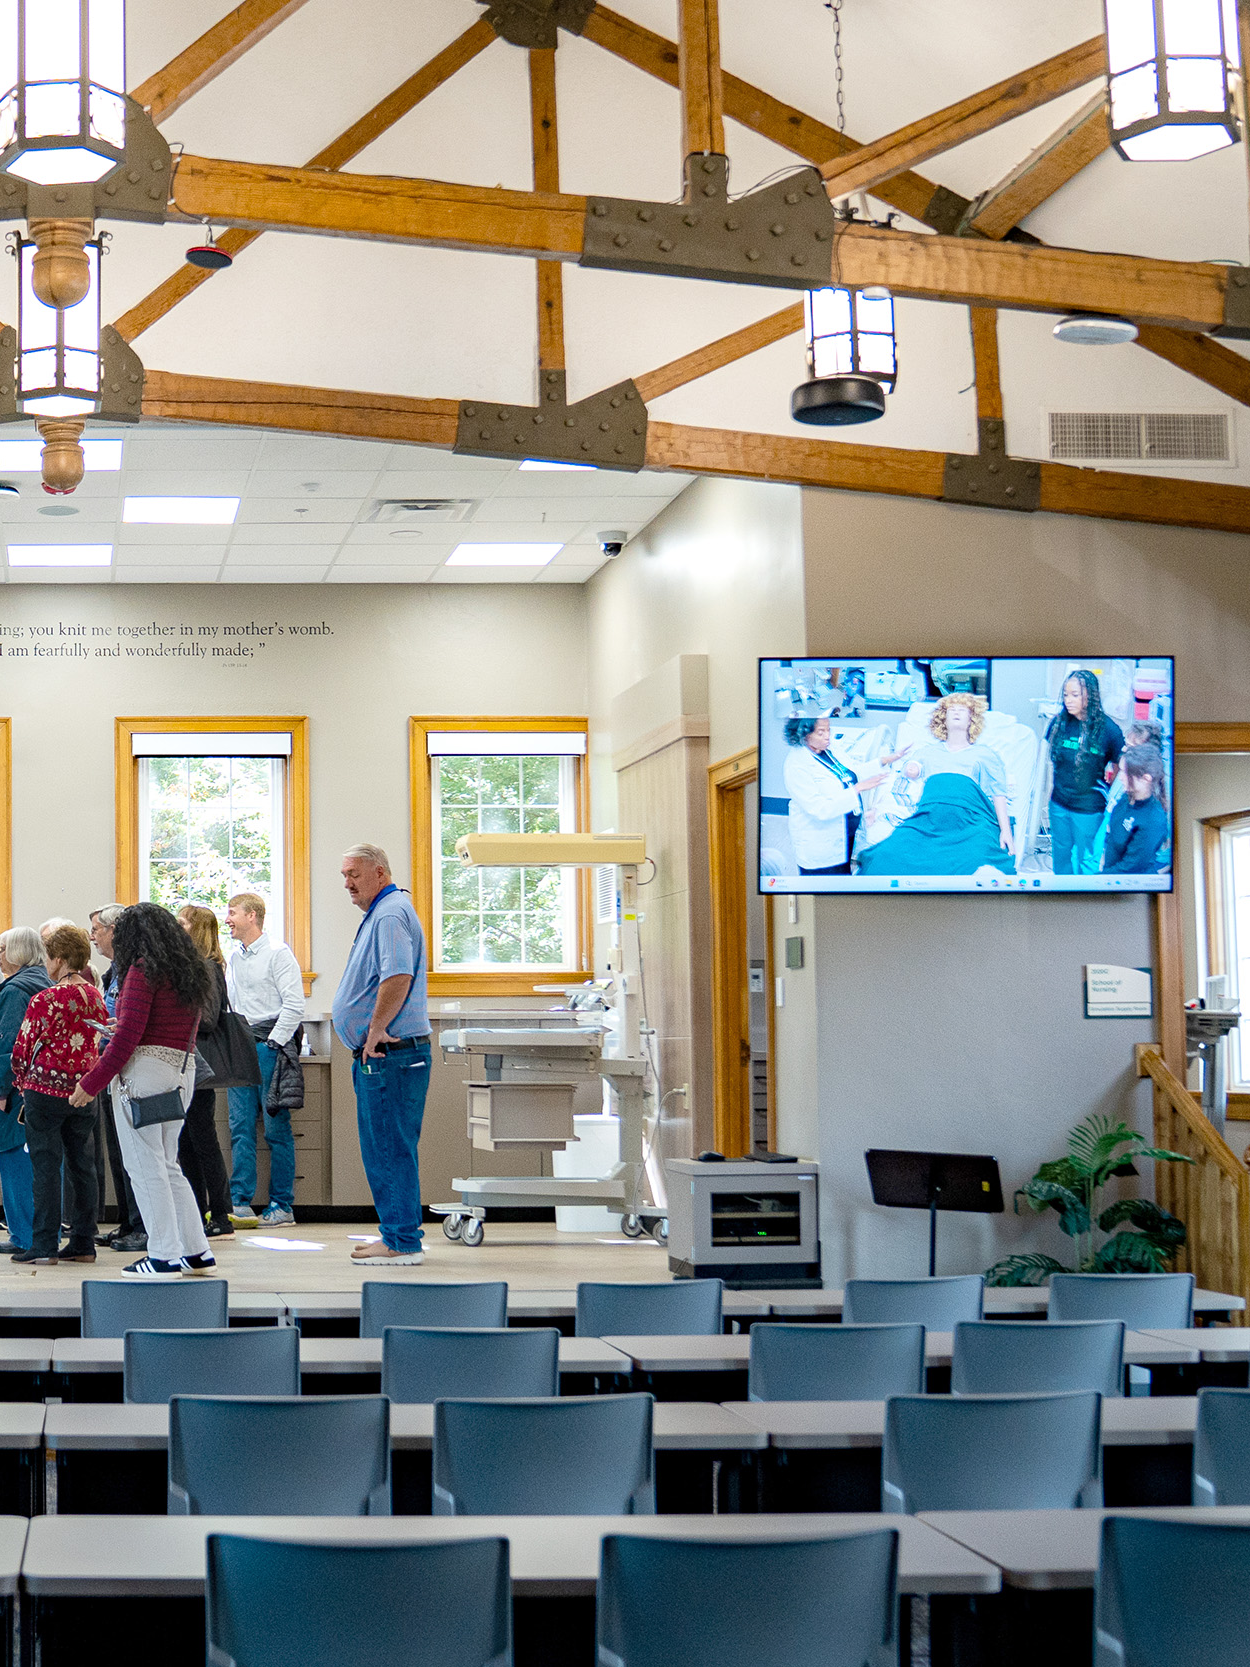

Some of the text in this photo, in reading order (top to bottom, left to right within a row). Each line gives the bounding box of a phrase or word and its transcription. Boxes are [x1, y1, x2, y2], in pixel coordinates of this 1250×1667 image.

[29, 626, 54, 638] you
[58, 622, 87, 636] knit
[91, 626, 112, 636] me
[117, 621, 176, 639] together
[180, 623, 193, 636] in
[197, 626, 219, 638] my
[223, 621, 284, 636] mother’s
[288, 621, 335, 636] womb.
[7, 647, 29, 657] am
[33, 642, 90, 660] fearfully
[94, 642, 121, 657] and
[125, 642, 207, 659] wonderfully
[211, 642, 254, 659] made;
